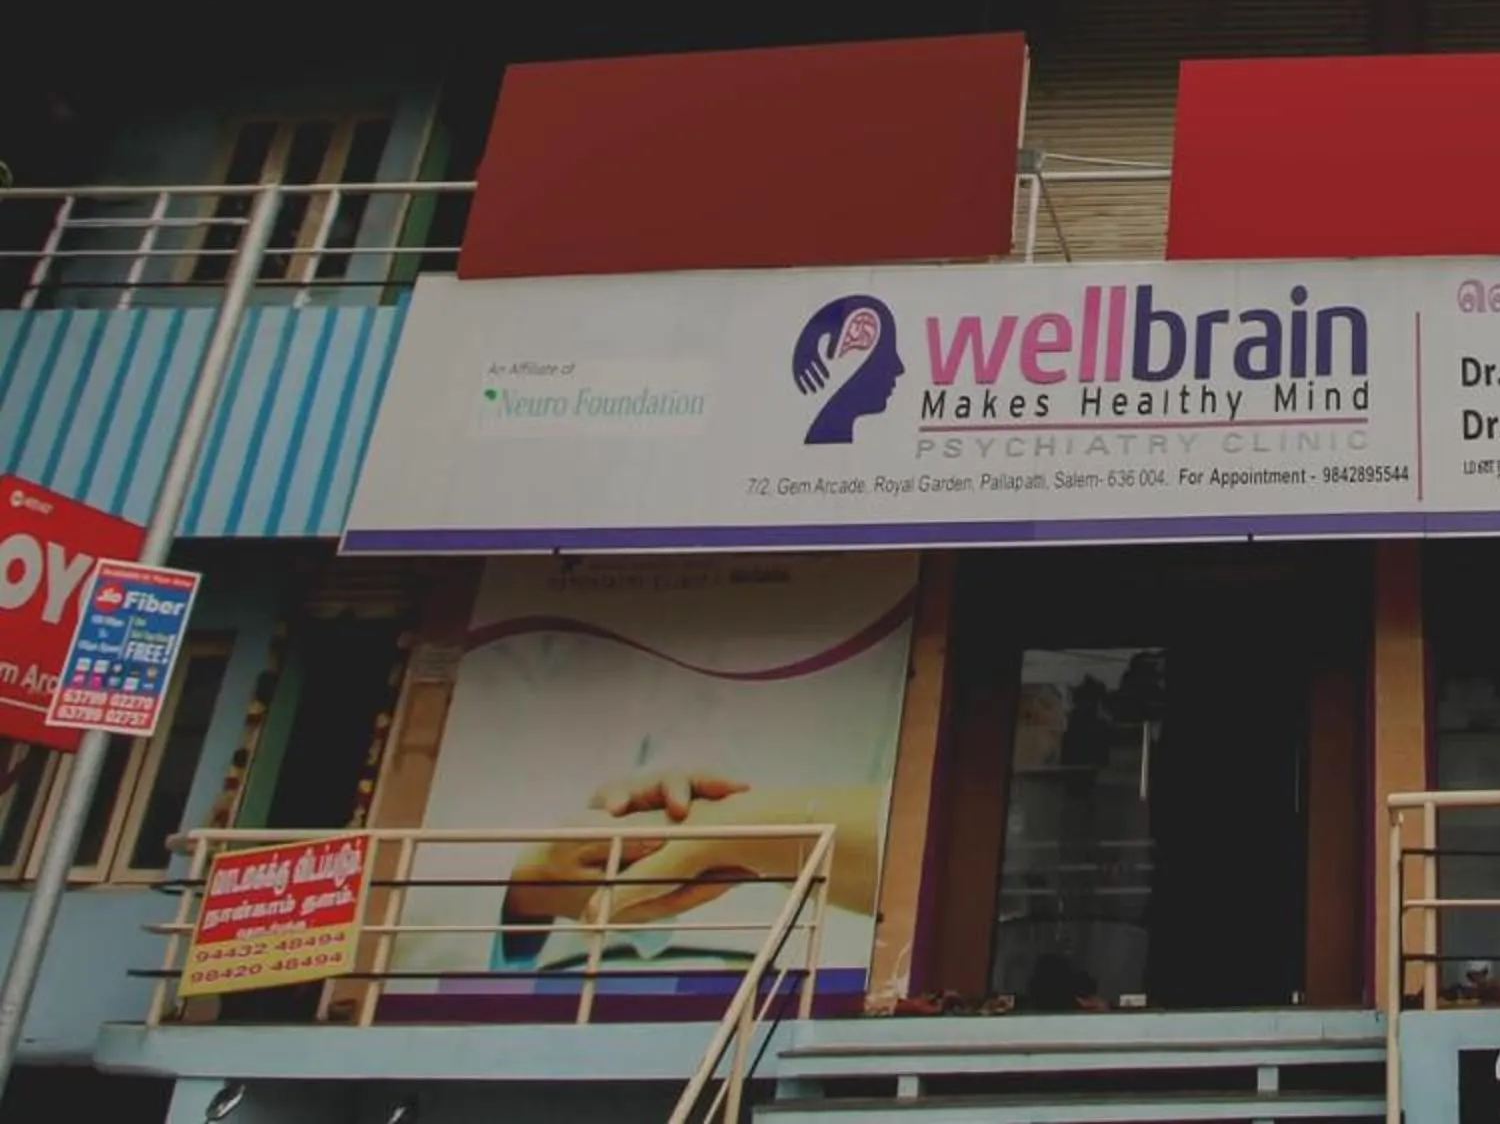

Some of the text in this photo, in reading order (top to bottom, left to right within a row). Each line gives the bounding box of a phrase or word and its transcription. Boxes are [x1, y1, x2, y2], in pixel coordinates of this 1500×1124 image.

[925, 284, 1368, 385] wellbrain
[501, 385, 705, 418] Neuro Foundation
[921, 380, 1369, 420] Makes Healthy Mind
[915, 429, 1369, 460] PSYCHIATRY CLINIC
[776, 477, 812, 496] Gem
[873, 475, 913, 497] Royal
[1107, 468, 1138, 488] 636
[1179, 468, 1203, 486] For
[1209, 466, 1307, 489] Appointment
[1322, 464, 1410, 484] 9842895544
[0, 533, 96, 624] OY
[123, 590, 186, 616] Fiber
